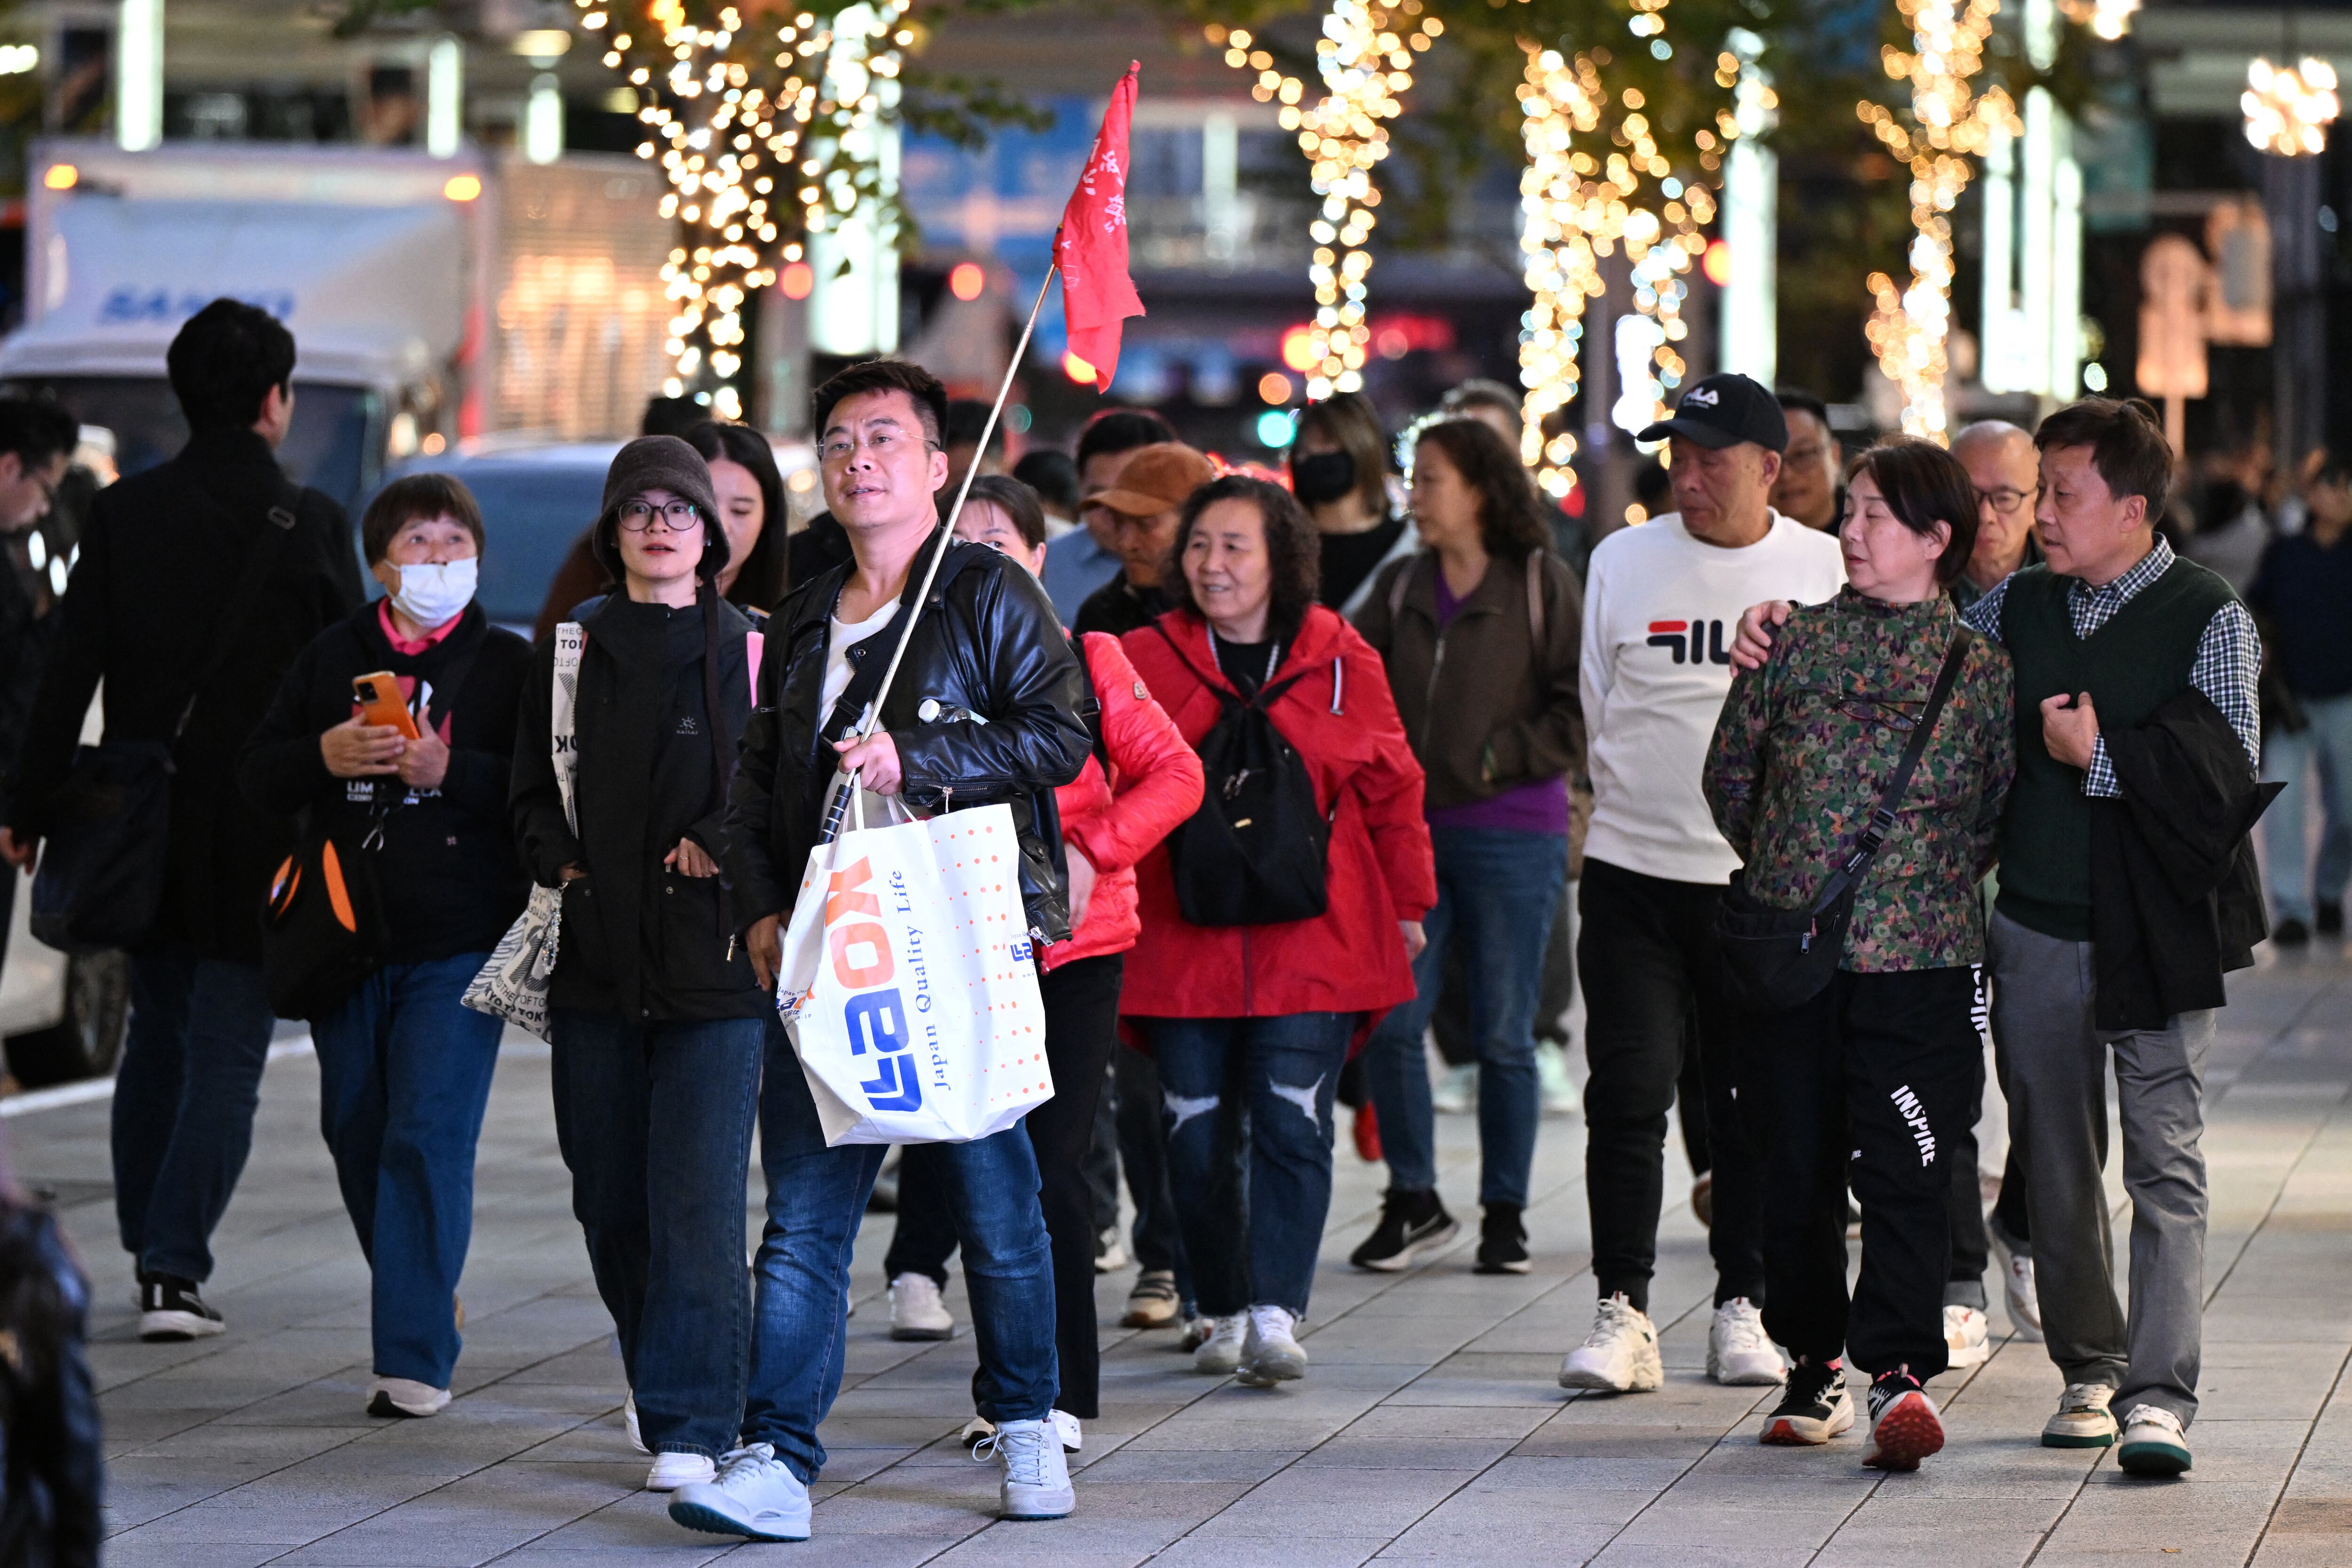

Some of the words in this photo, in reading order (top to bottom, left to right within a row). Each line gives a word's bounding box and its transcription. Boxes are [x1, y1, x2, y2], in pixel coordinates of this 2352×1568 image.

[889, 869, 912, 914] Life
[907, 925, 932, 1013] Quality
[925, 1025, 951, 1090] Japan
[1890, 1084, 1935, 1167] INSPIRE
